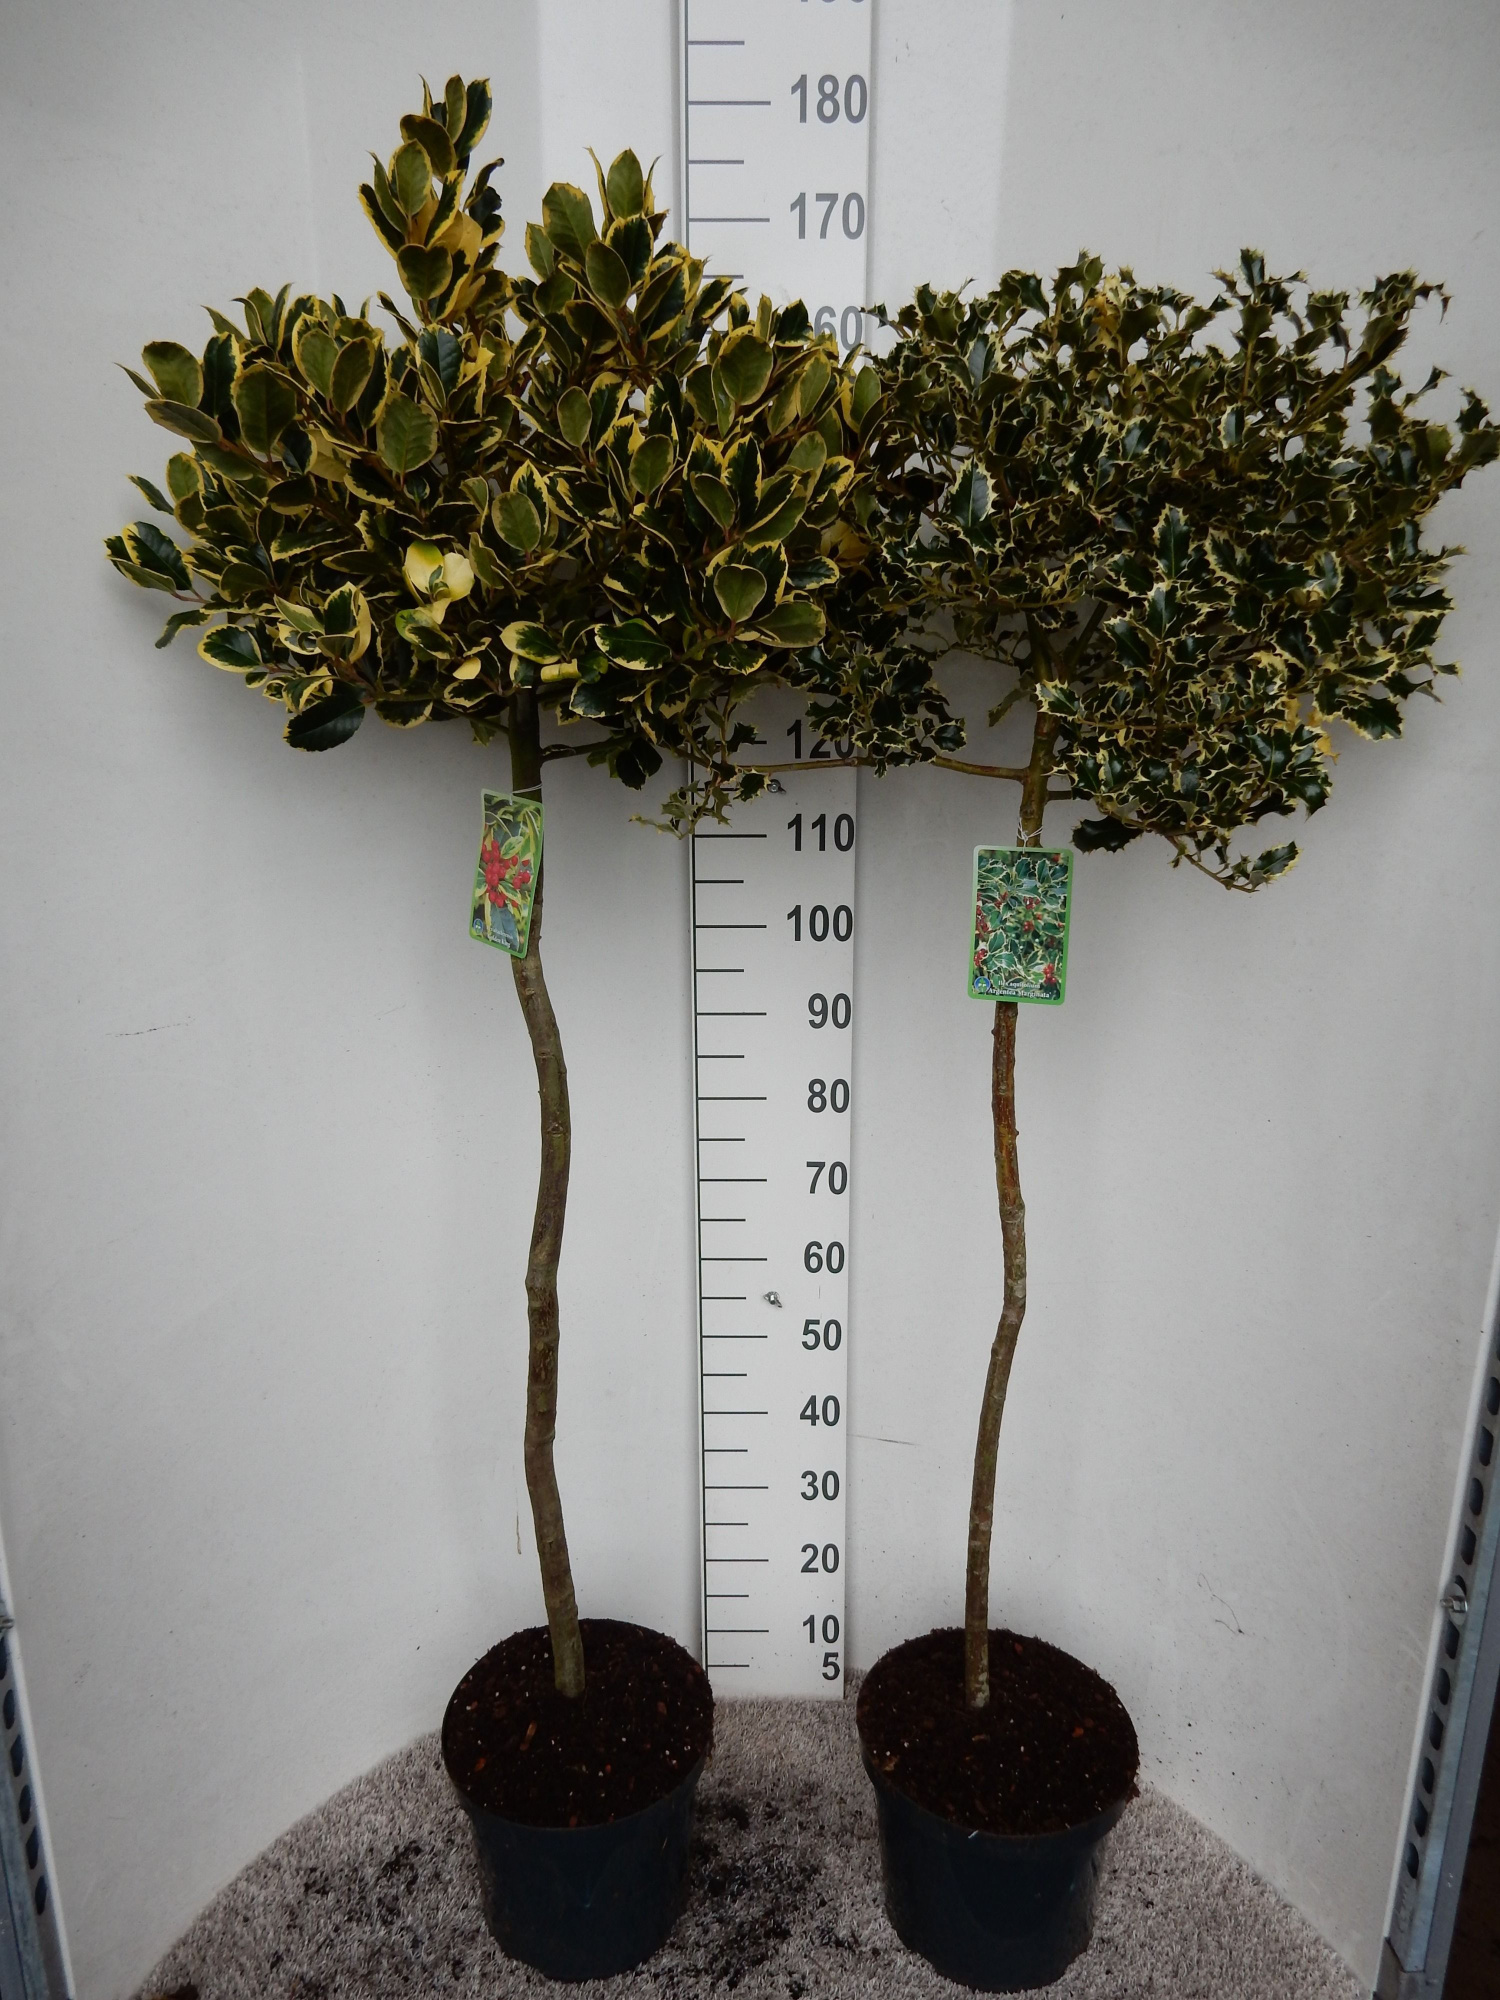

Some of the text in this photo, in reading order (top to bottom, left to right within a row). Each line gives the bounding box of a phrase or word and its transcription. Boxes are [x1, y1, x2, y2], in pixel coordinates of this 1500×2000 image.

[791, 75, 867, 123] 180
[791, 193, 864, 239] 170
[814, 306, 862, 351] 60
[788, 814, 854, 851] 110
[788, 905, 852, 941] 100
[808, 993, 851, 1029] 90
[808, 1079, 849, 1113] 80
[807, 1162, 847, 1194] 70
[804, 1241, 844, 1273] 60
[802, 1320, 841, 1350] 50
[800, 1395, 840, 1426] 40
[801, 1471, 839, 1500] 30
[801, 1544, 839, 1573] 20
[803, 1615, 839, 1643] 10
[822, 1653, 840, 1680] 5
